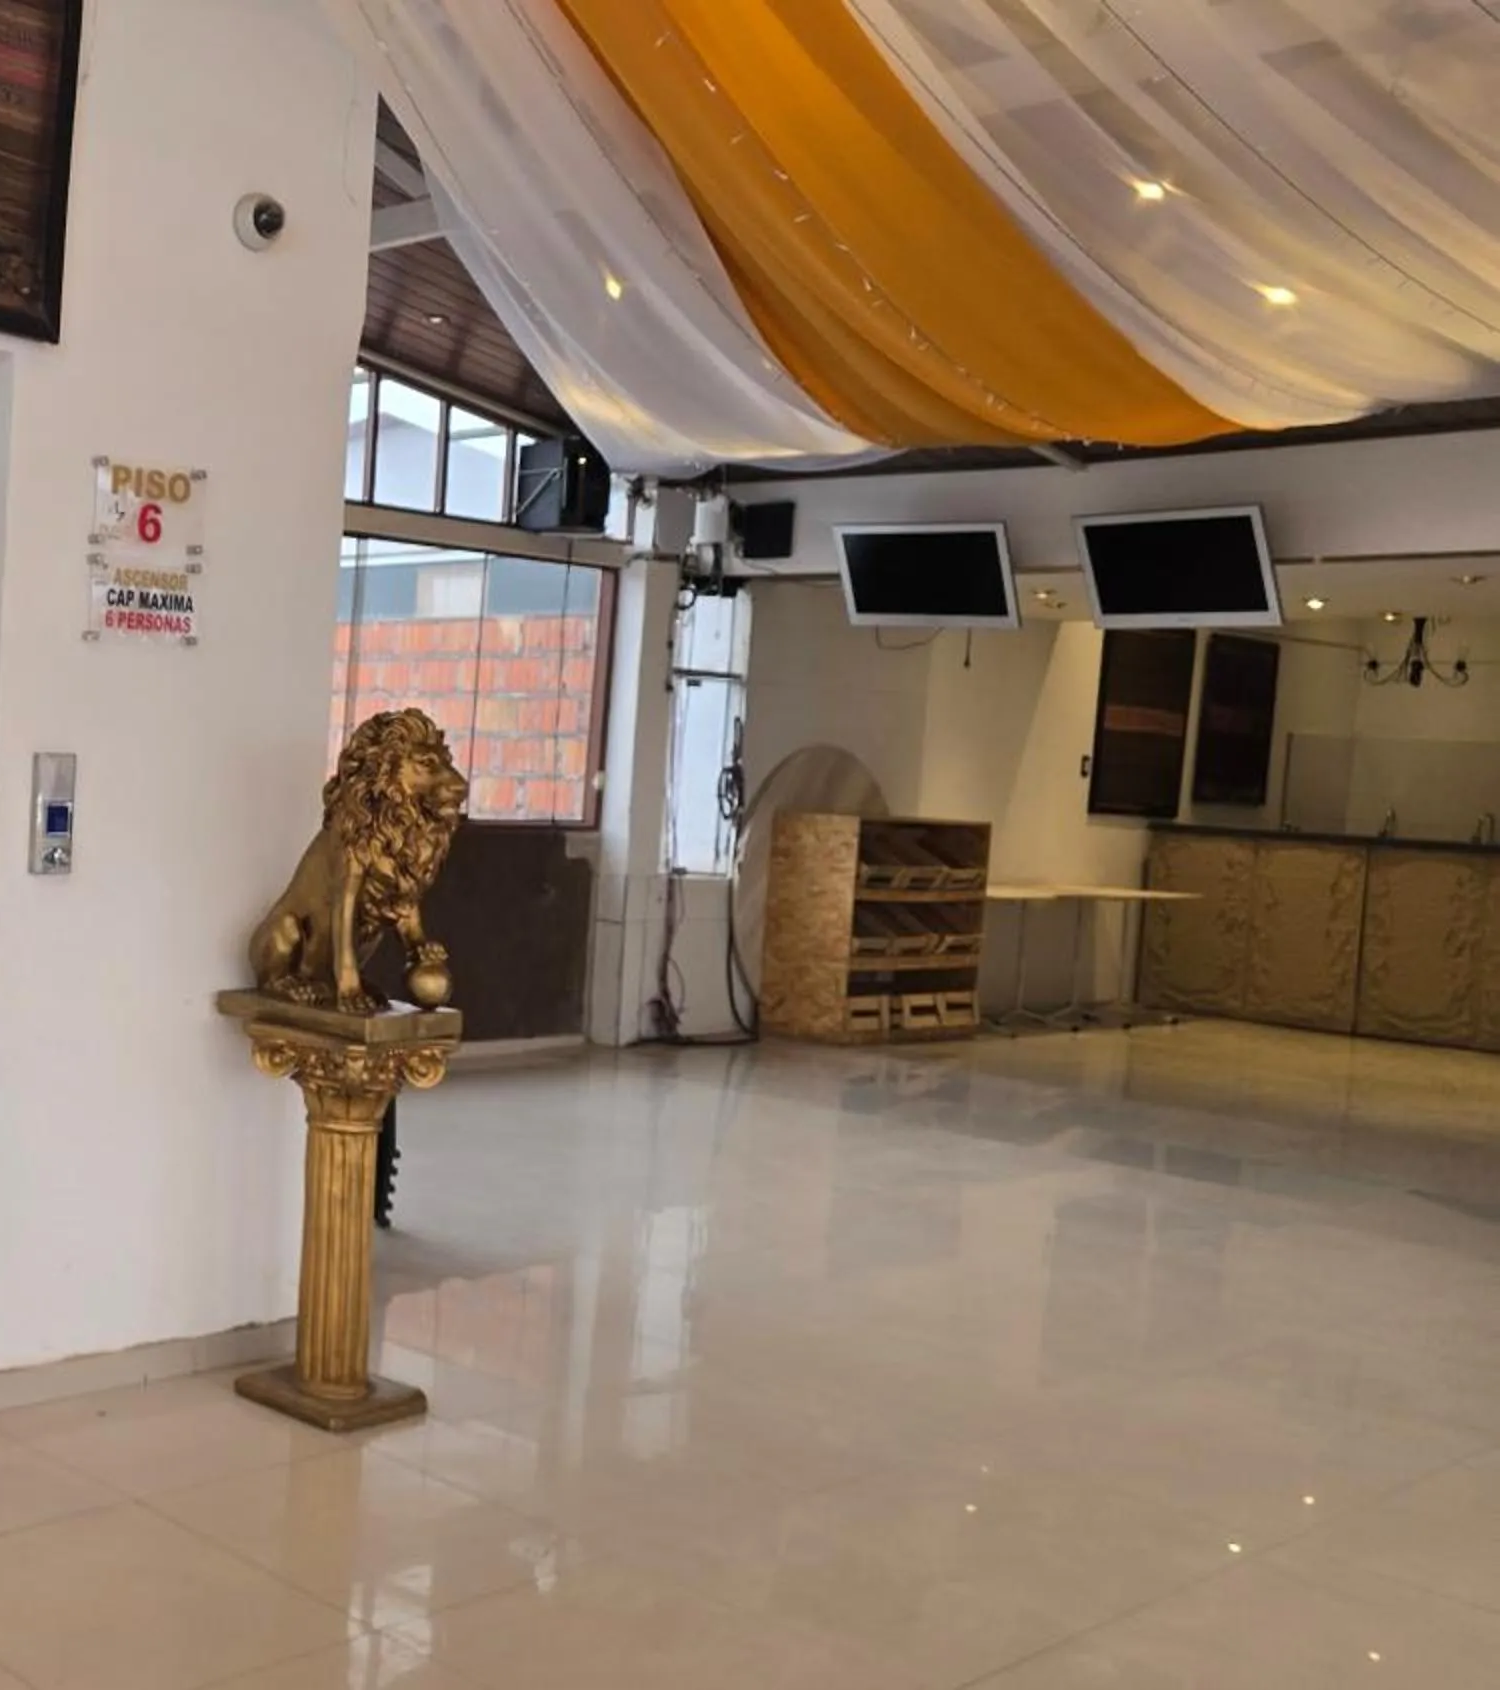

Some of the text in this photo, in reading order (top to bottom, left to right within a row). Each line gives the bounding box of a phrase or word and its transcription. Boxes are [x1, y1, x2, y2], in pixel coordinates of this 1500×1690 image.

[111, 464, 191, 504] PISO
[137, 502, 163, 544] 6
[112, 567, 189, 592] ASCENSOR
[106, 588, 194, 613] CAP MAXIMA
[104, 611, 192, 634] 6 PERSONAS
